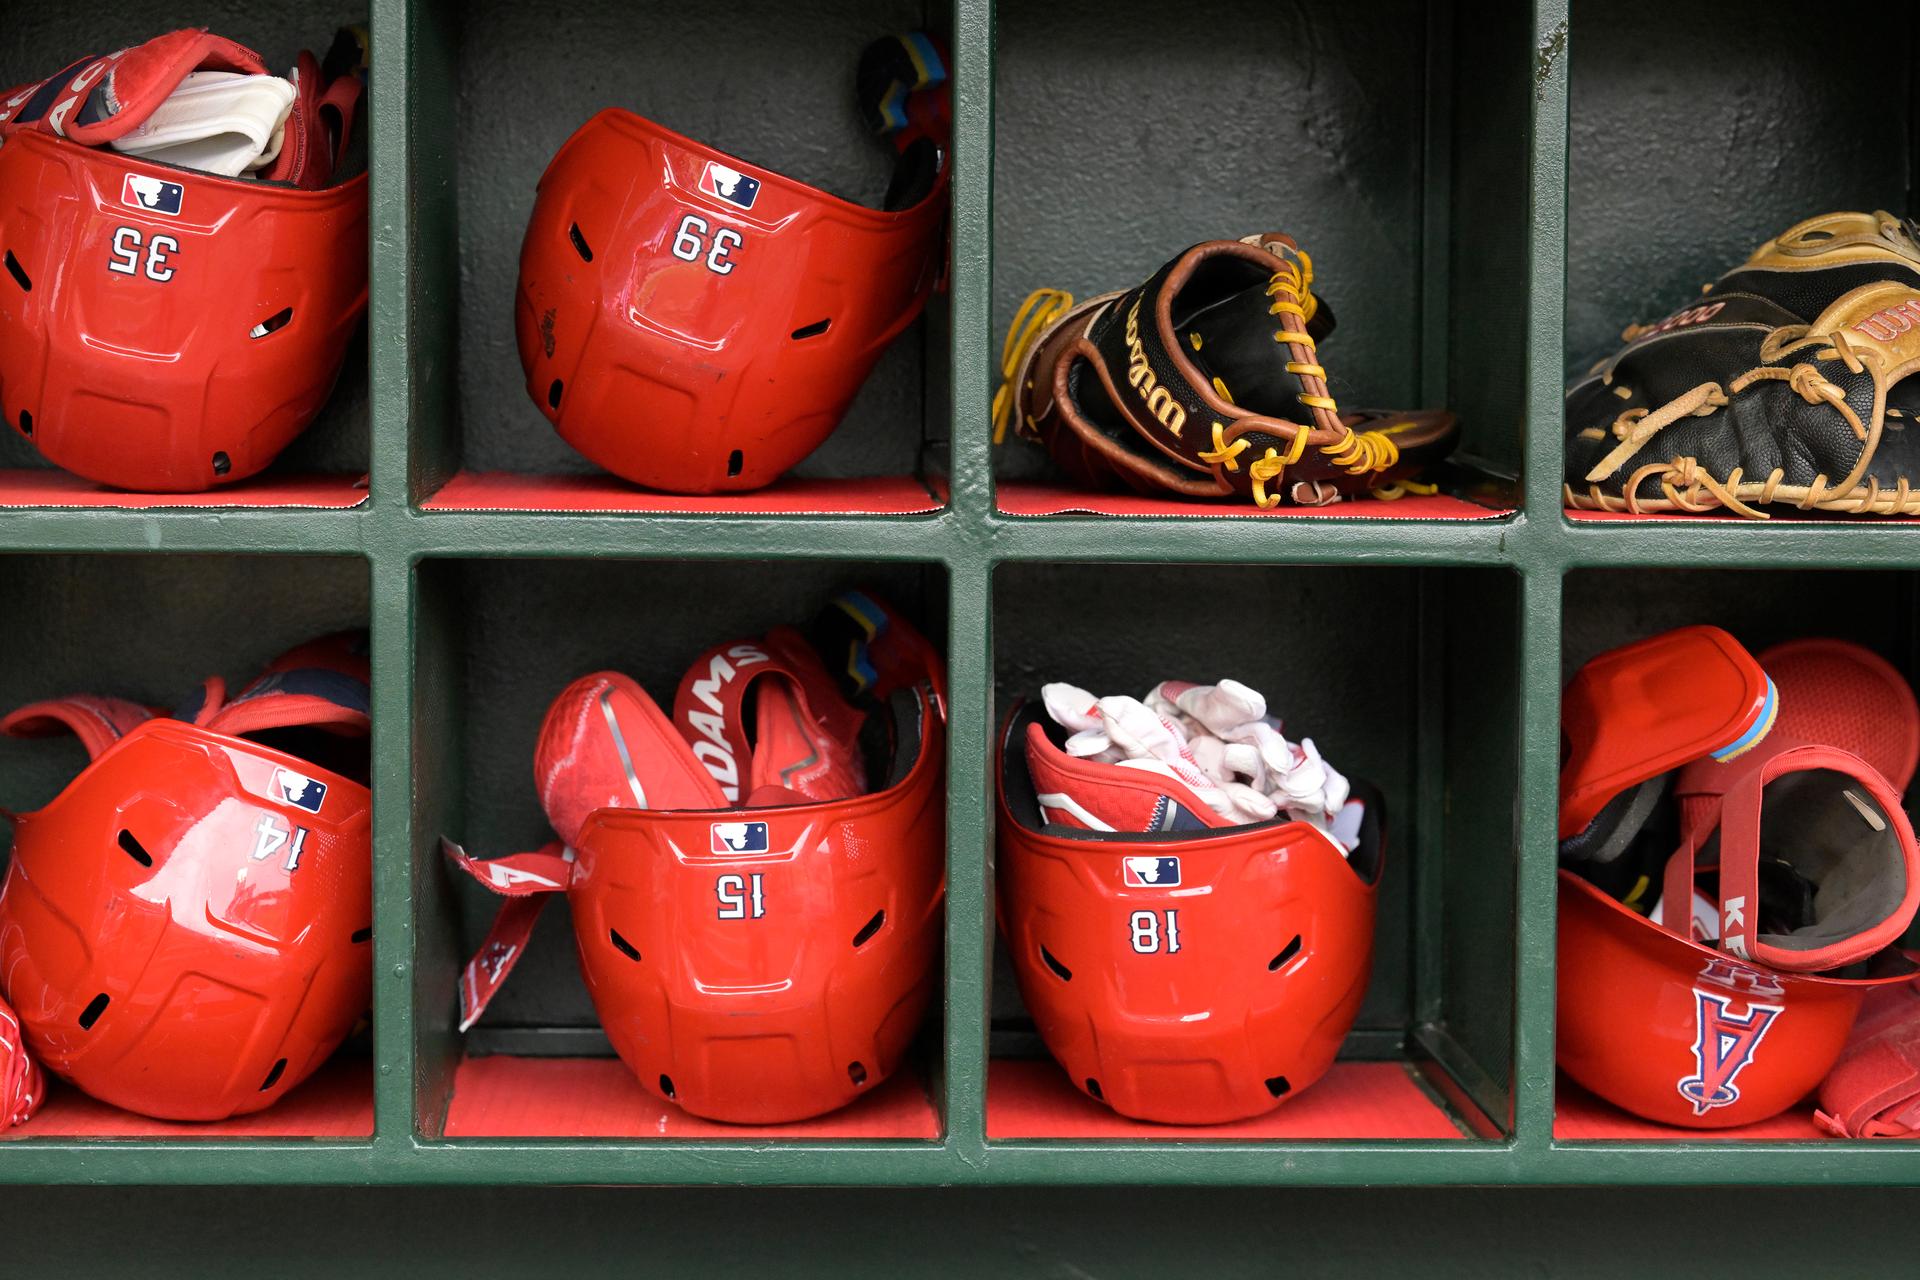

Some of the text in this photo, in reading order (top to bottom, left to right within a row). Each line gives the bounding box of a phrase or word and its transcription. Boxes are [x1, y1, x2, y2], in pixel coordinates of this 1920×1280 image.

[108, 225, 181, 283] 35
[671, 213, 743, 275] 39
[1126, 288, 1187, 439] Wilson
[252, 812, 309, 874] 14
[715, 873, 768, 921] 15
[1128, 908, 1181, 955] 18
[1677, 987, 1785, 1115] A
